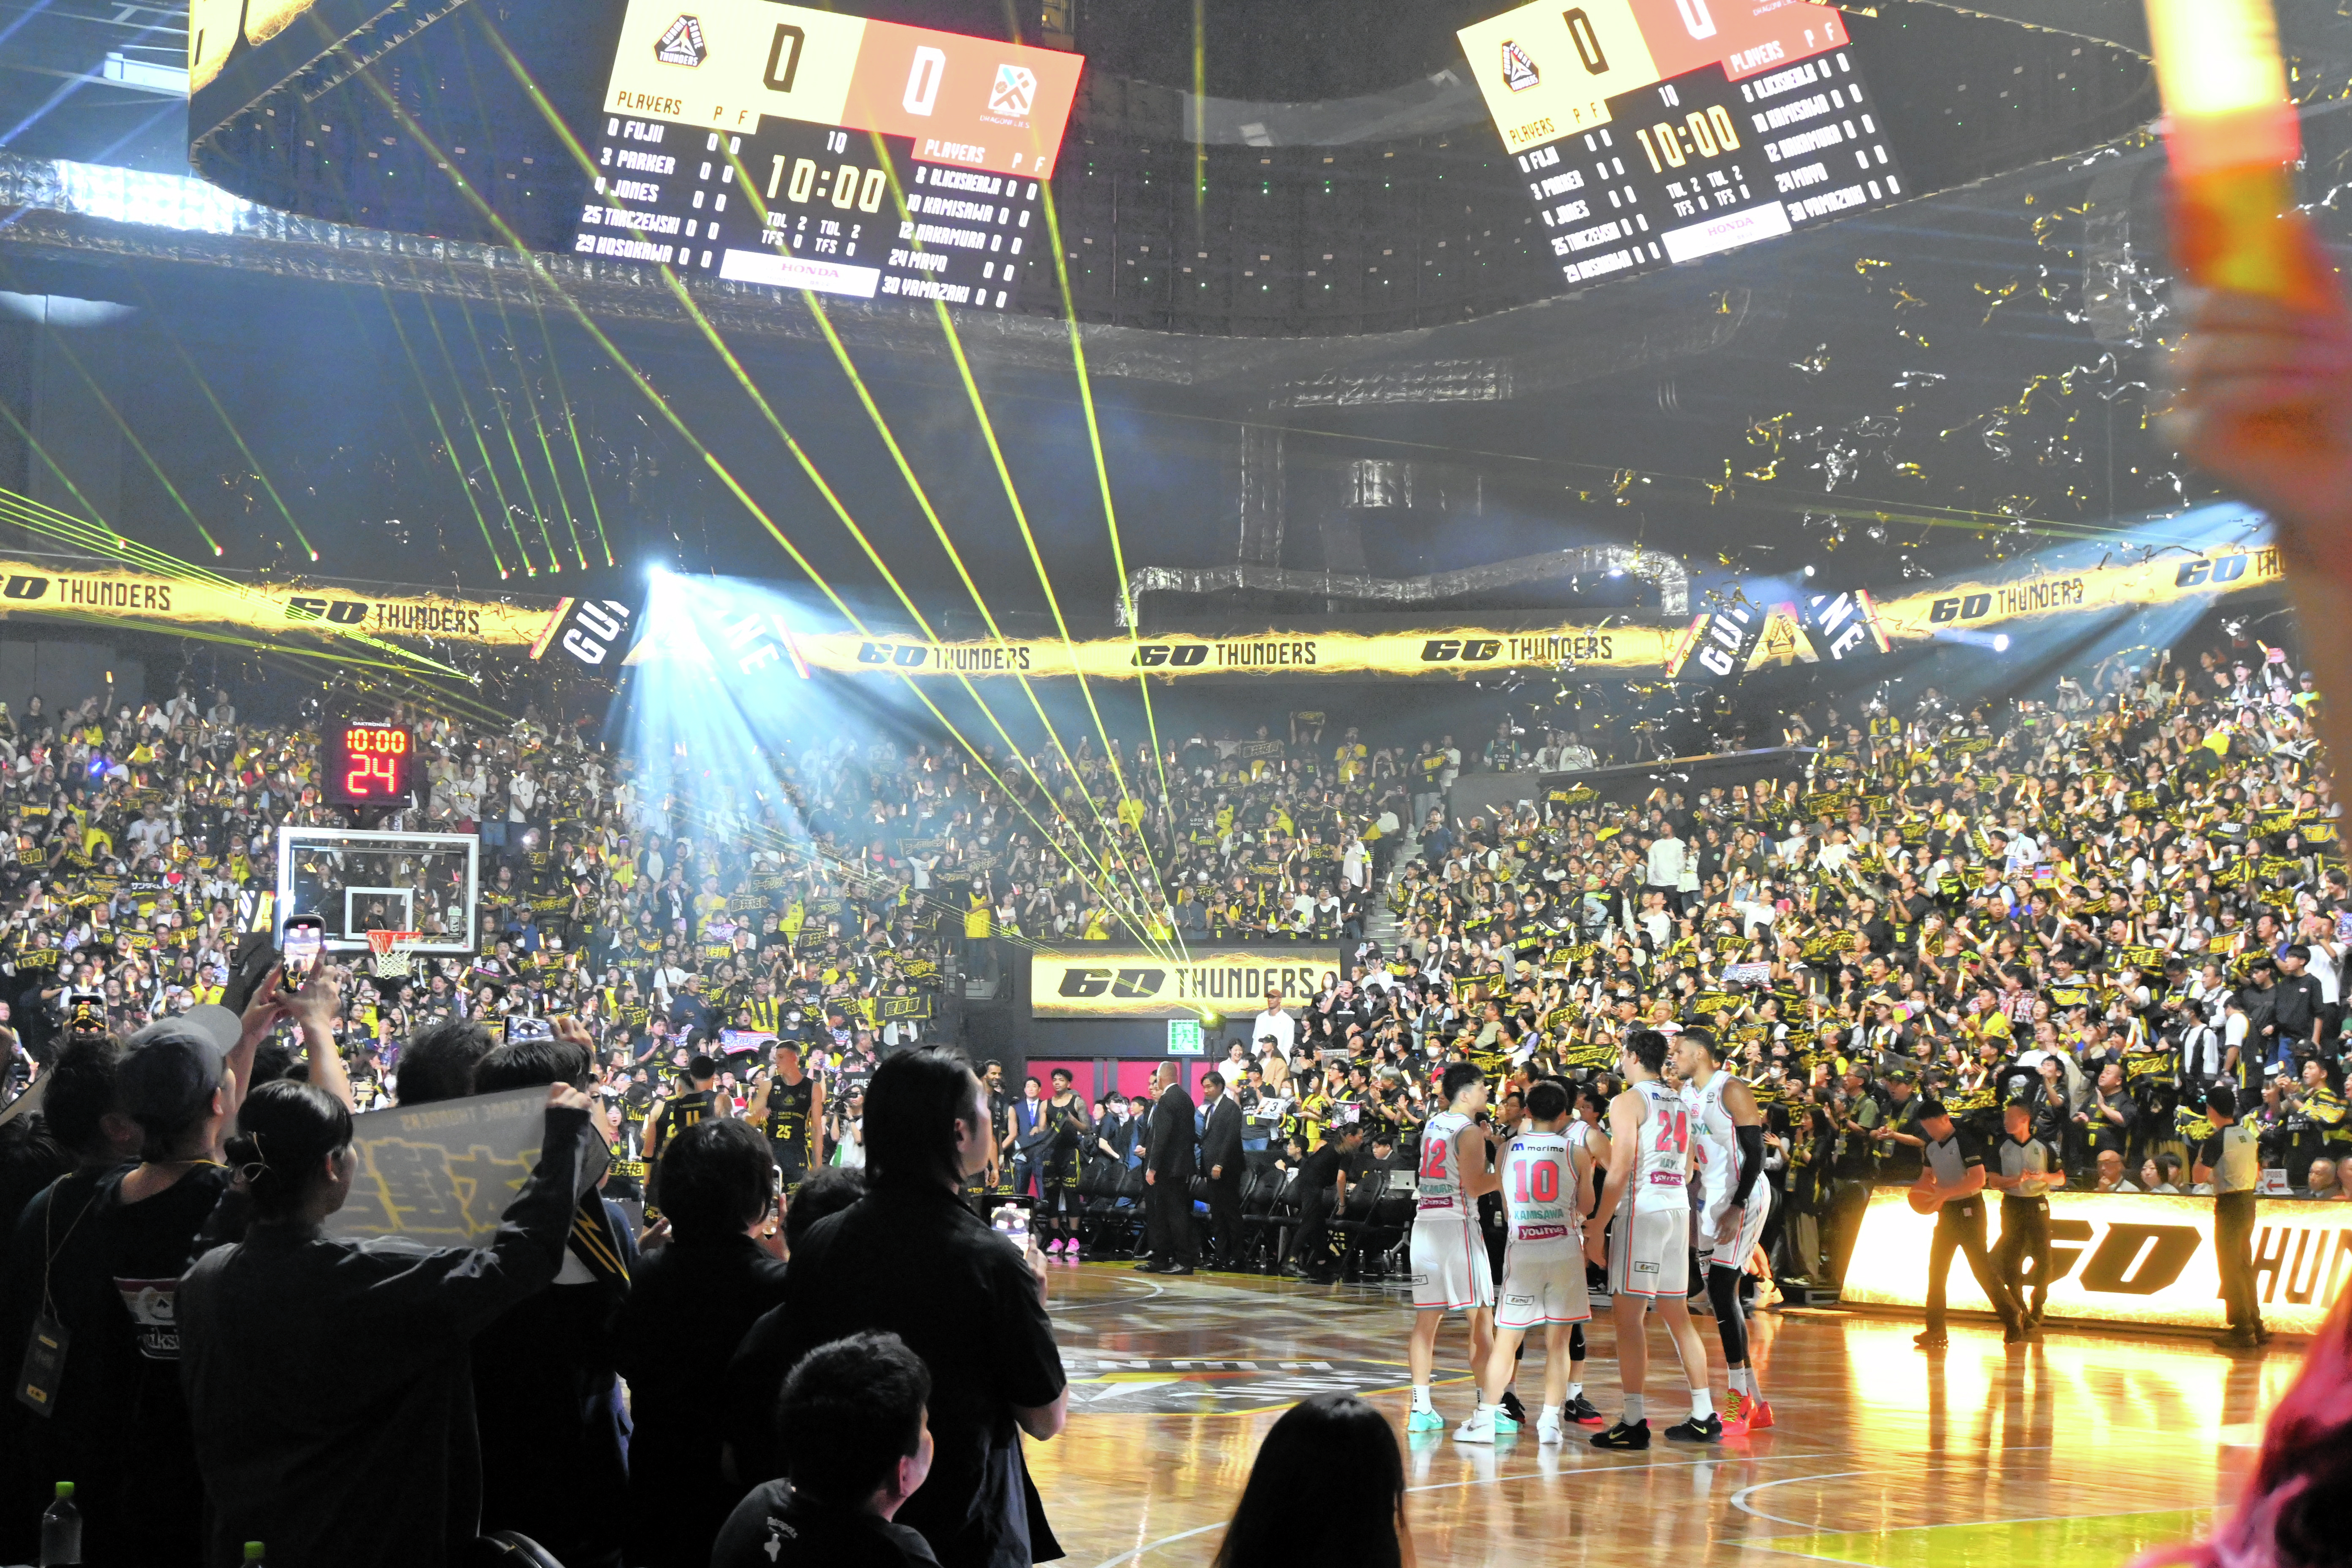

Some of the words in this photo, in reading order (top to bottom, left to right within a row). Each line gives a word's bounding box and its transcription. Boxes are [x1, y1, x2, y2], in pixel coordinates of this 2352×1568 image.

[1562, 7, 1610, 75] 0
[1730, 40, 1784, 73] PLAYERS
[1804, 29, 1814, 48] P
[1825, 22, 1834, 41] F
[660, 51, 698, 66] THUNDERS
[763, 24, 805, 93] 0
[902, 45, 946, 116] 0
[617, 91, 682, 115] PLAYERS
[713, 106, 723, 121] P
[738, 110, 748, 124] F
[607, 118, 619, 136] 0
[624, 121, 664, 143] FUJII
[707, 133, 719, 151] 0
[729, 136, 741, 154] 0
[1509, 118, 1555, 145] PLAYERS
[1636, 105, 1740, 174] 10:00
[601, 147, 612, 165] 3
[617, 149, 676, 175] PARKER
[699, 162, 711, 180] 0
[722, 165, 734, 183] 0
[924, 139, 985, 163] PLAYERS
[1012, 153, 1022, 168] P
[1034, 156, 1045, 171] F
[594, 177, 606, 194] 4
[610, 179, 660, 202] JONES
[693, 190, 704, 209] 0
[715, 193, 727, 212] 0
[767, 154, 887, 213] 10:00
[915, 166, 927, 183] 8
[1006, 180, 1017, 198] 0
[1026, 183, 1037, 200] 0
[1530, 183, 1542, 200] 3
[1690, 177, 1701, 192] 2
[1732, 165, 1743, 180] 2
[582, 205, 603, 224] 25
[605, 207, 681, 235] TARCZEWSKI
[685, 219, 697, 237] 0
[708, 222, 720, 240] 0
[906, 193, 922, 212] 10
[922, 196, 994, 222] KAMISAWA
[998, 207, 1009, 225] 0
[1018, 210, 1030, 227] 0
[1707, 217, 1754, 236] HONDA
[762, 229, 785, 246] TFS
[793, 234, 803, 248] 0
[815, 237, 838, 254] TFS
[846, 242, 856, 256] 0
[798, 216, 808, 230] 2
[851, 224, 861, 238] 2
[898, 221, 914, 239] 12
[915, 223, 986, 249] NAKAMURA
[990, 234, 1002, 251] 0
[1011, 237, 1022, 255] 0
[575, 234, 596, 253] 29
[596, 236, 673, 262] HOSOKAWA
[678, 247, 690, 265] 0
[701, 250, 712, 268] 0
[889, 248, 909, 267] 24
[908, 251, 948, 272] MAYO
[983, 261, 994, 279] 0
[1003, 264, 1014, 281] 0
[781, 263, 839, 278] HONDA
[882, 275, 901, 294] 30
[901, 278, 970, 303] YAMAZAKI
[975, 288, 987, 305] 0
[995, 291, 1007, 308] 0
[2175, 554, 2248, 587] GO
[0, 574, 50, 599] O
[58, 579, 171, 610] THUNDERS
[1930, 593, 1992, 623] GO
[1998, 578, 2083, 614] THUNDERS
[285, 597, 369, 624] GO
[376, 604, 480, 634] THUNDERS
[857, 642, 928, 667] GO
[934, 647, 1030, 670] THUNDERS
[1131, 644, 1209, 666] GO
[1216, 641, 1316, 665] THUNDERS
[1421, 639, 1503, 661] GO
[1508, 636, 1612, 660] THUNDERS
[348, 729, 405, 753] 10:00
[348, 754, 395, 793] 24
[1058, 969, 1166, 997] GO
[1175, 967, 1314, 998] THUNDERS
[1270, 1102, 1278, 1112] 3
[776, 1125, 792, 1139] 25
[1655, 1109, 1689, 1154] 24
[1420, 1137, 1447, 1179] 12
[1513, 1159, 1559, 1203] 10
[1514, 1208, 1563, 1220] KAMISAWA
[1521, 1226, 1564, 1238] youme
